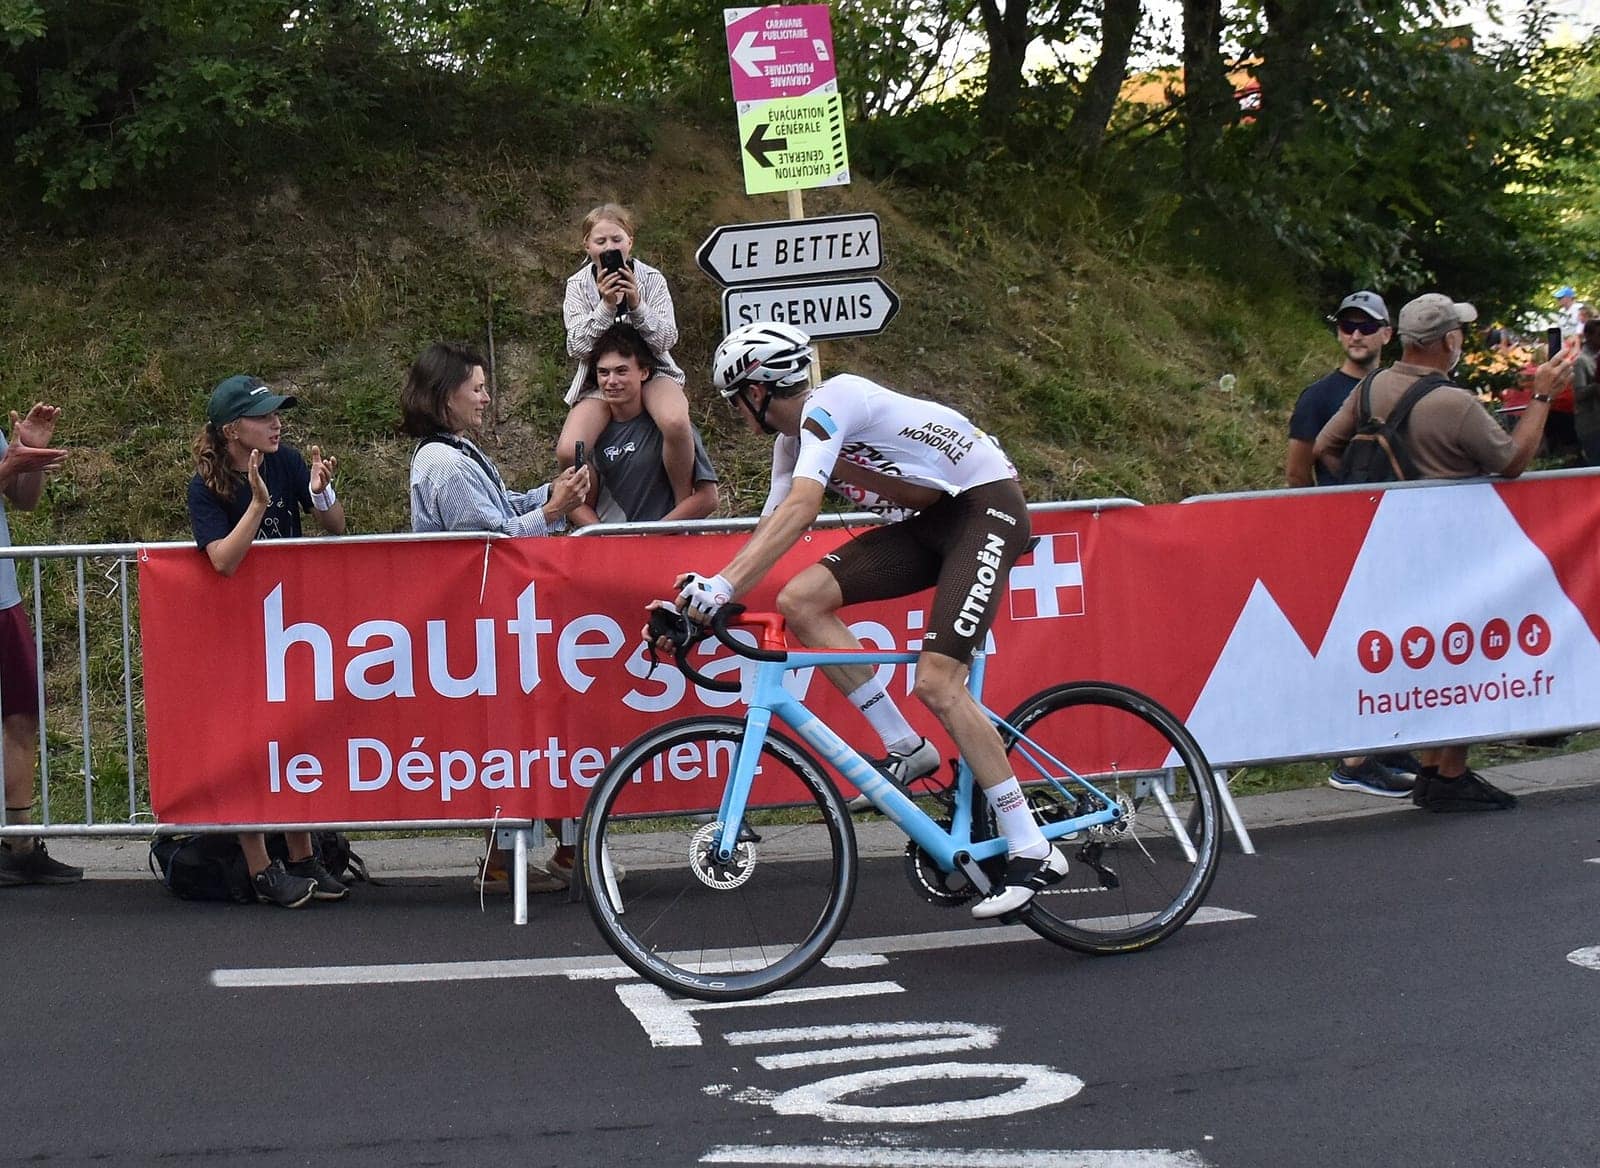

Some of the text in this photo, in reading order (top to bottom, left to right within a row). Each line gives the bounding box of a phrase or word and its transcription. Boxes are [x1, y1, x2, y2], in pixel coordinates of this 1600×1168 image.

[762, 28, 808, 40] PUBLICITAIRE
[765, 18, 803, 29] CARAVANE
[764, 62, 815, 76] PUBLICITAIRE
[770, 75, 811, 88] CARAVANE
[768, 106, 825, 122] ÉVACUATION
[775, 121, 821, 136] GÉNÉRALE
[778, 149, 824, 164] GÉNÉRALE
[775, 163, 831, 179] ÉVACUATION
[731, 230, 872, 270] LE BETTEX
[770, 294, 873, 326] GERVAIS
[898, 427, 964, 466] MONDIALE
[922, 422, 974, 452] AG2R LA
[953, 533, 1006, 637] CITROËN
[263, 580, 997, 713] hautesaoi
[1358, 670, 1555, 715] hautesavoie.fr
[268, 736, 763, 801] le Départeen
